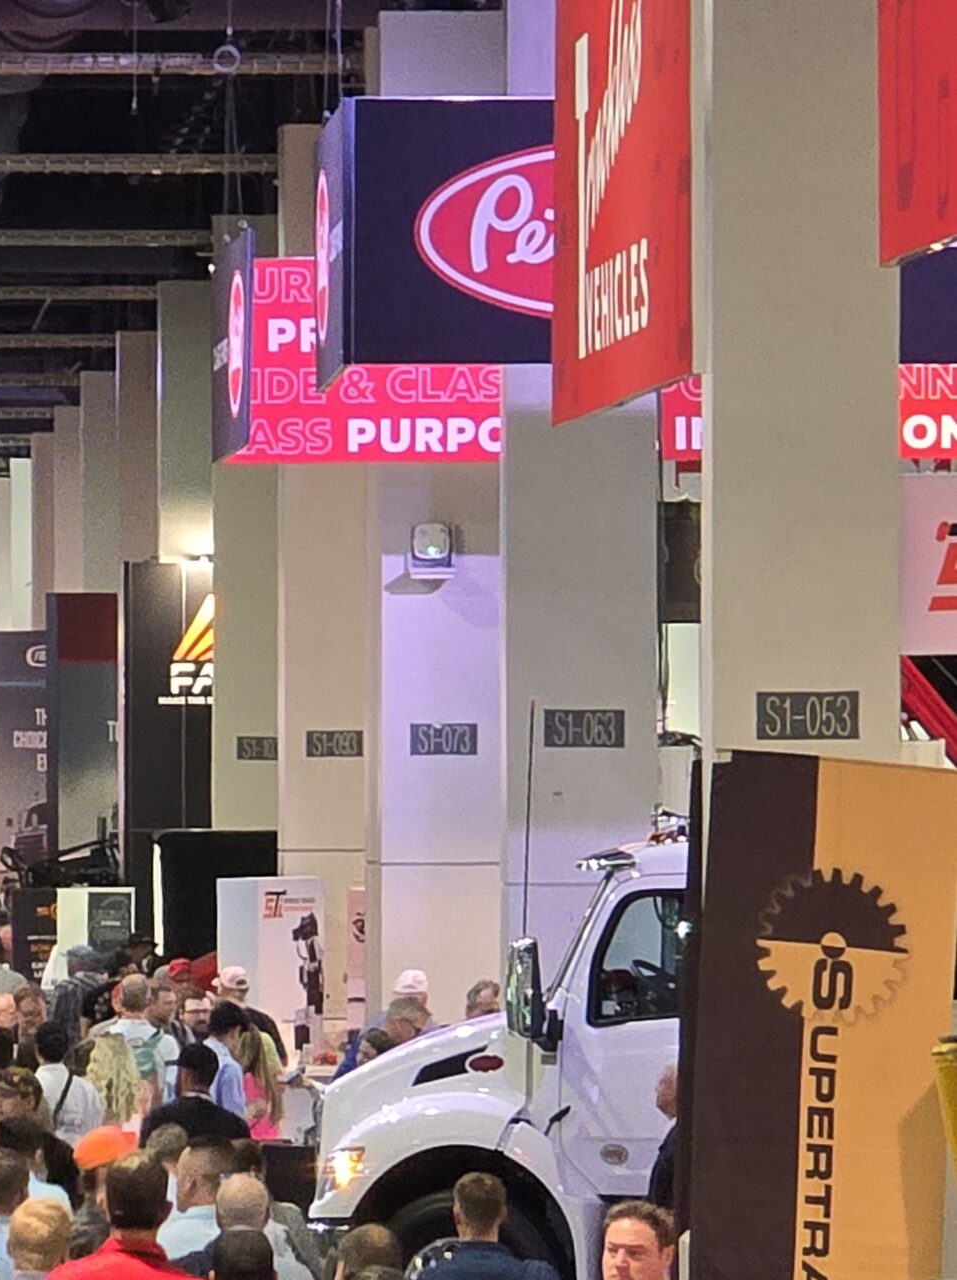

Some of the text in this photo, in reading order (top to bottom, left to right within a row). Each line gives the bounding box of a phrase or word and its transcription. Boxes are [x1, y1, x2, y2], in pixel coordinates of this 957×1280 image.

[585, 237, 649, 355] VEHICLES
[339, 367, 376, 404] &
[386, 366, 501, 403] CLAS
[899, 364, 957, 400] NN
[248, 417, 502, 455] ASS PURPO
[170, 662, 214, 695] FA
[553, 711, 616, 746] S1-063
[764, 695, 851, 736] S1-053
[417, 725, 471, 754] S1-073
